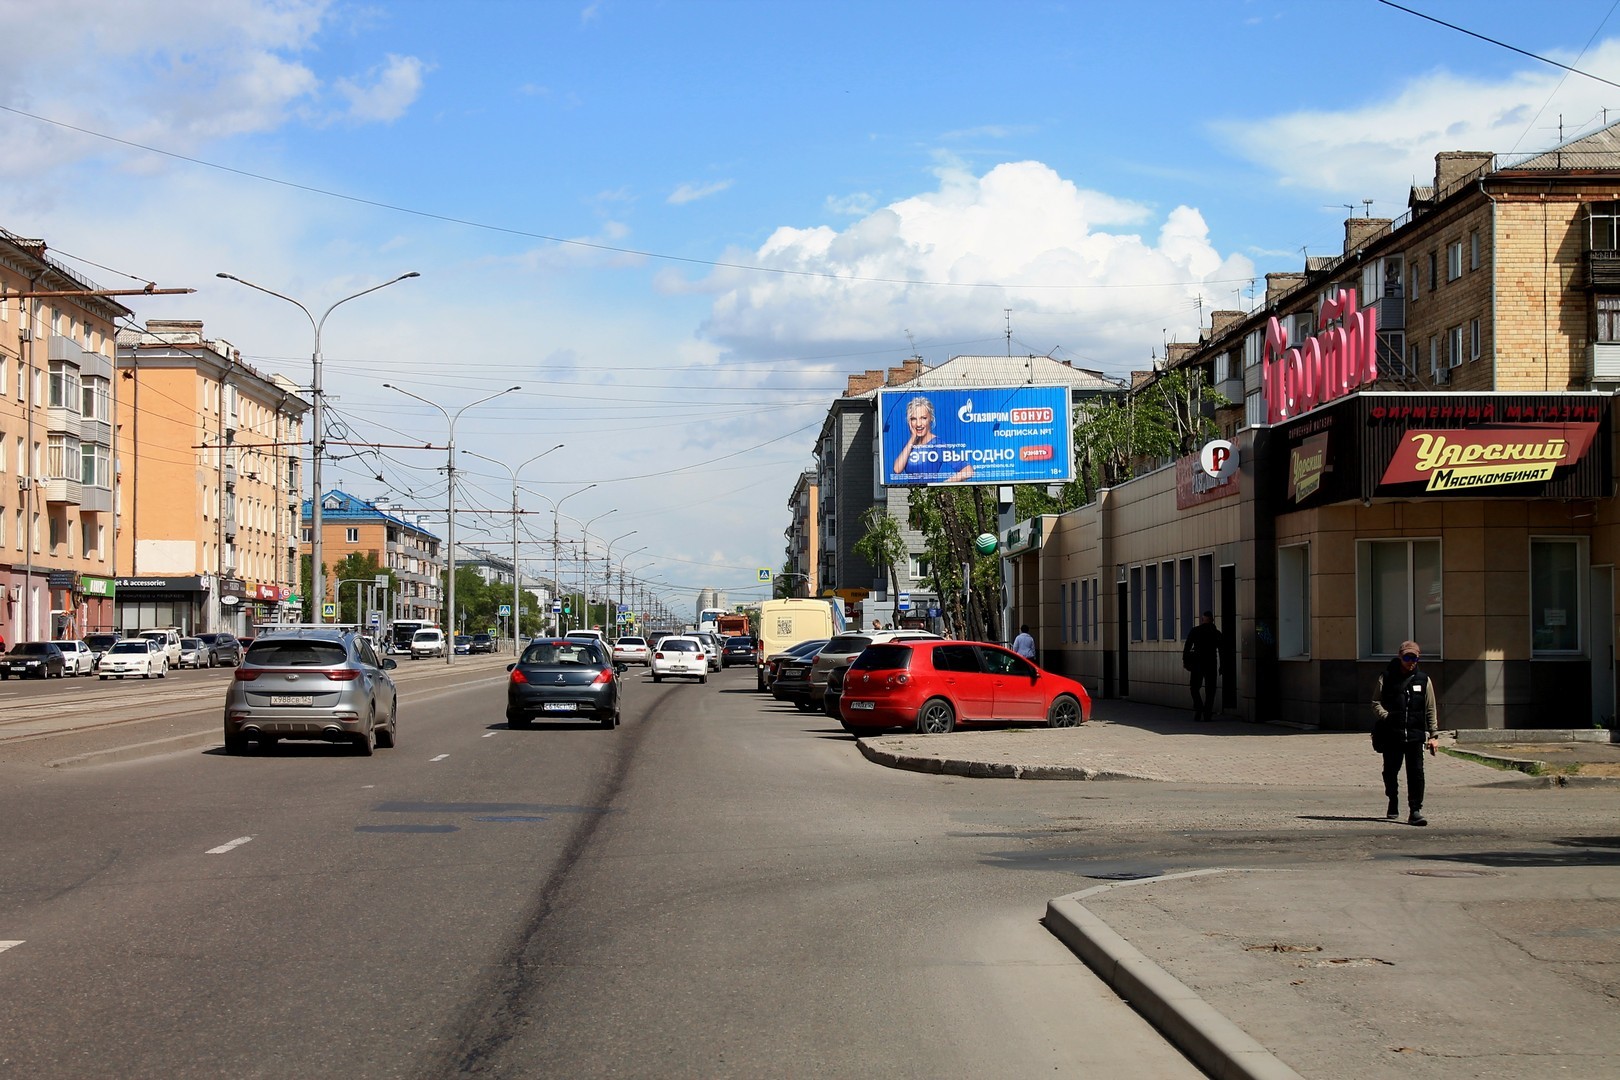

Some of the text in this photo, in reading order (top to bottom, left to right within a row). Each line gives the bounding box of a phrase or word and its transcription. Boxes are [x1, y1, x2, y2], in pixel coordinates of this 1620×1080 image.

[1372, 403, 1600, 419] ФИРМЕННЫЙ МАГАЗИН
[1013, 411, 1050, 422] БОНУС
[994, 429, 1038, 438] ПОДПИСКА
[909, 449, 1015, 464] ЭТО ВЫГОДНО
[1023, 450, 1047, 459] узнать
[1411, 433, 1567, 472] Уярский
[1050, 468, 1062, 476] 18+
[130, 579, 166, 588] accessories
